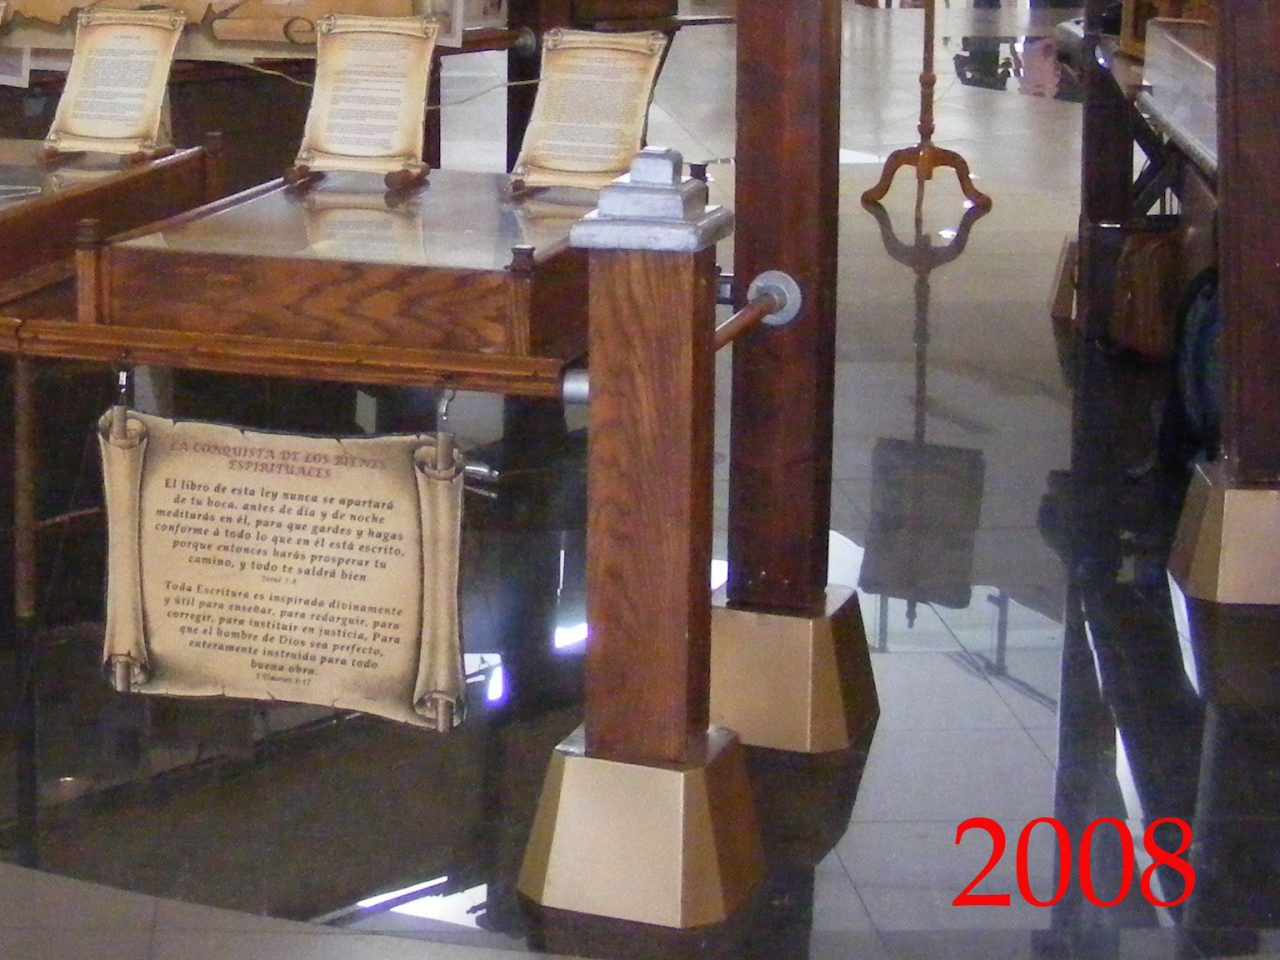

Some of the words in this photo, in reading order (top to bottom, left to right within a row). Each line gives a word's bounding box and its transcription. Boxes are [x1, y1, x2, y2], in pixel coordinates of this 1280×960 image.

[193, 443, 276, 459] CONQUISTA
[279, 449, 301, 461] DE
[304, 451, 330, 465] LOS
[334, 454, 387, 470] BIENES
[228, 460, 332, 478] ESPIRITUALES
[165, 478, 178, 489] El
[181, 479, 210, 492] libro
[214, 482, 227, 494] de
[231, 486, 256, 497] esta
[260, 487, 279, 502] ley
[282, 491, 318, 503] nunca
[322, 496, 335, 505] se
[338, 498, 394, 510] apartará
[173, 494, 187, 505] de
[191, 496, 203, 507] tu
[242, 503, 275, 513] antes
[279, 504, 293, 515] de
[320, 510, 328, 521] y
[331, 510, 346, 520] de
[350, 513, 385, 525] noche
[155, 522, 210, 536] conforme
[224, 529, 252, 541] todo
[256, 531, 268, 542] lo
[271, 534, 293, 547] que
[296, 538, 310, 547] en
[329, 540, 355, 551] está
[156, 508, 216, 522] meditarás
[220, 515, 233, 524] en
[236, 515, 250, 527] él,
[255, 519, 283, 530] para
[286, 521, 308, 532] que
[311, 524, 352, 536] gardes
[356, 528, 364, 540] y
[367, 528, 404, 544] hagas
[172, 540, 213, 552] porque
[216, 543, 268, 557] entonces
[272, 547, 306, 561] harás
[310, 553, 370, 568] prosperar
[374, 559, 387, 570] tu
[188, 555, 234, 569] camino,
[239, 560, 247, 572] y
[250, 561, 278, 573] todo
[282, 563, 294, 574] te
[297, 566, 336, 579] saldrá
[163, 596, 171, 606] y
[198, 601, 225, 611] para
[280, 610, 306, 620] para
[372, 620, 400, 630] para
[165, 581, 192, 593] Toda
[196, 584, 250, 599] Escritura
[253, 592, 265, 601] es
[269, 593, 325, 609] inspirada
[328, 600, 404, 617] divinamente
[179, 624, 199, 636] que
[202, 626, 213, 636] el
[216, 627, 258, 642] hombre
[262, 633, 276, 643] de
[279, 635, 306, 647] Dios
[310, 640, 328, 650] sea
[218, 616, 245, 626] para
[249, 616, 298, 632] instituir
[302, 625, 315, 634] en
[372, 632, 401, 645] Para
[188, 639, 259, 656] enteramente
[320, 656, 347, 666] para
[250, 658, 285, 672] buena
